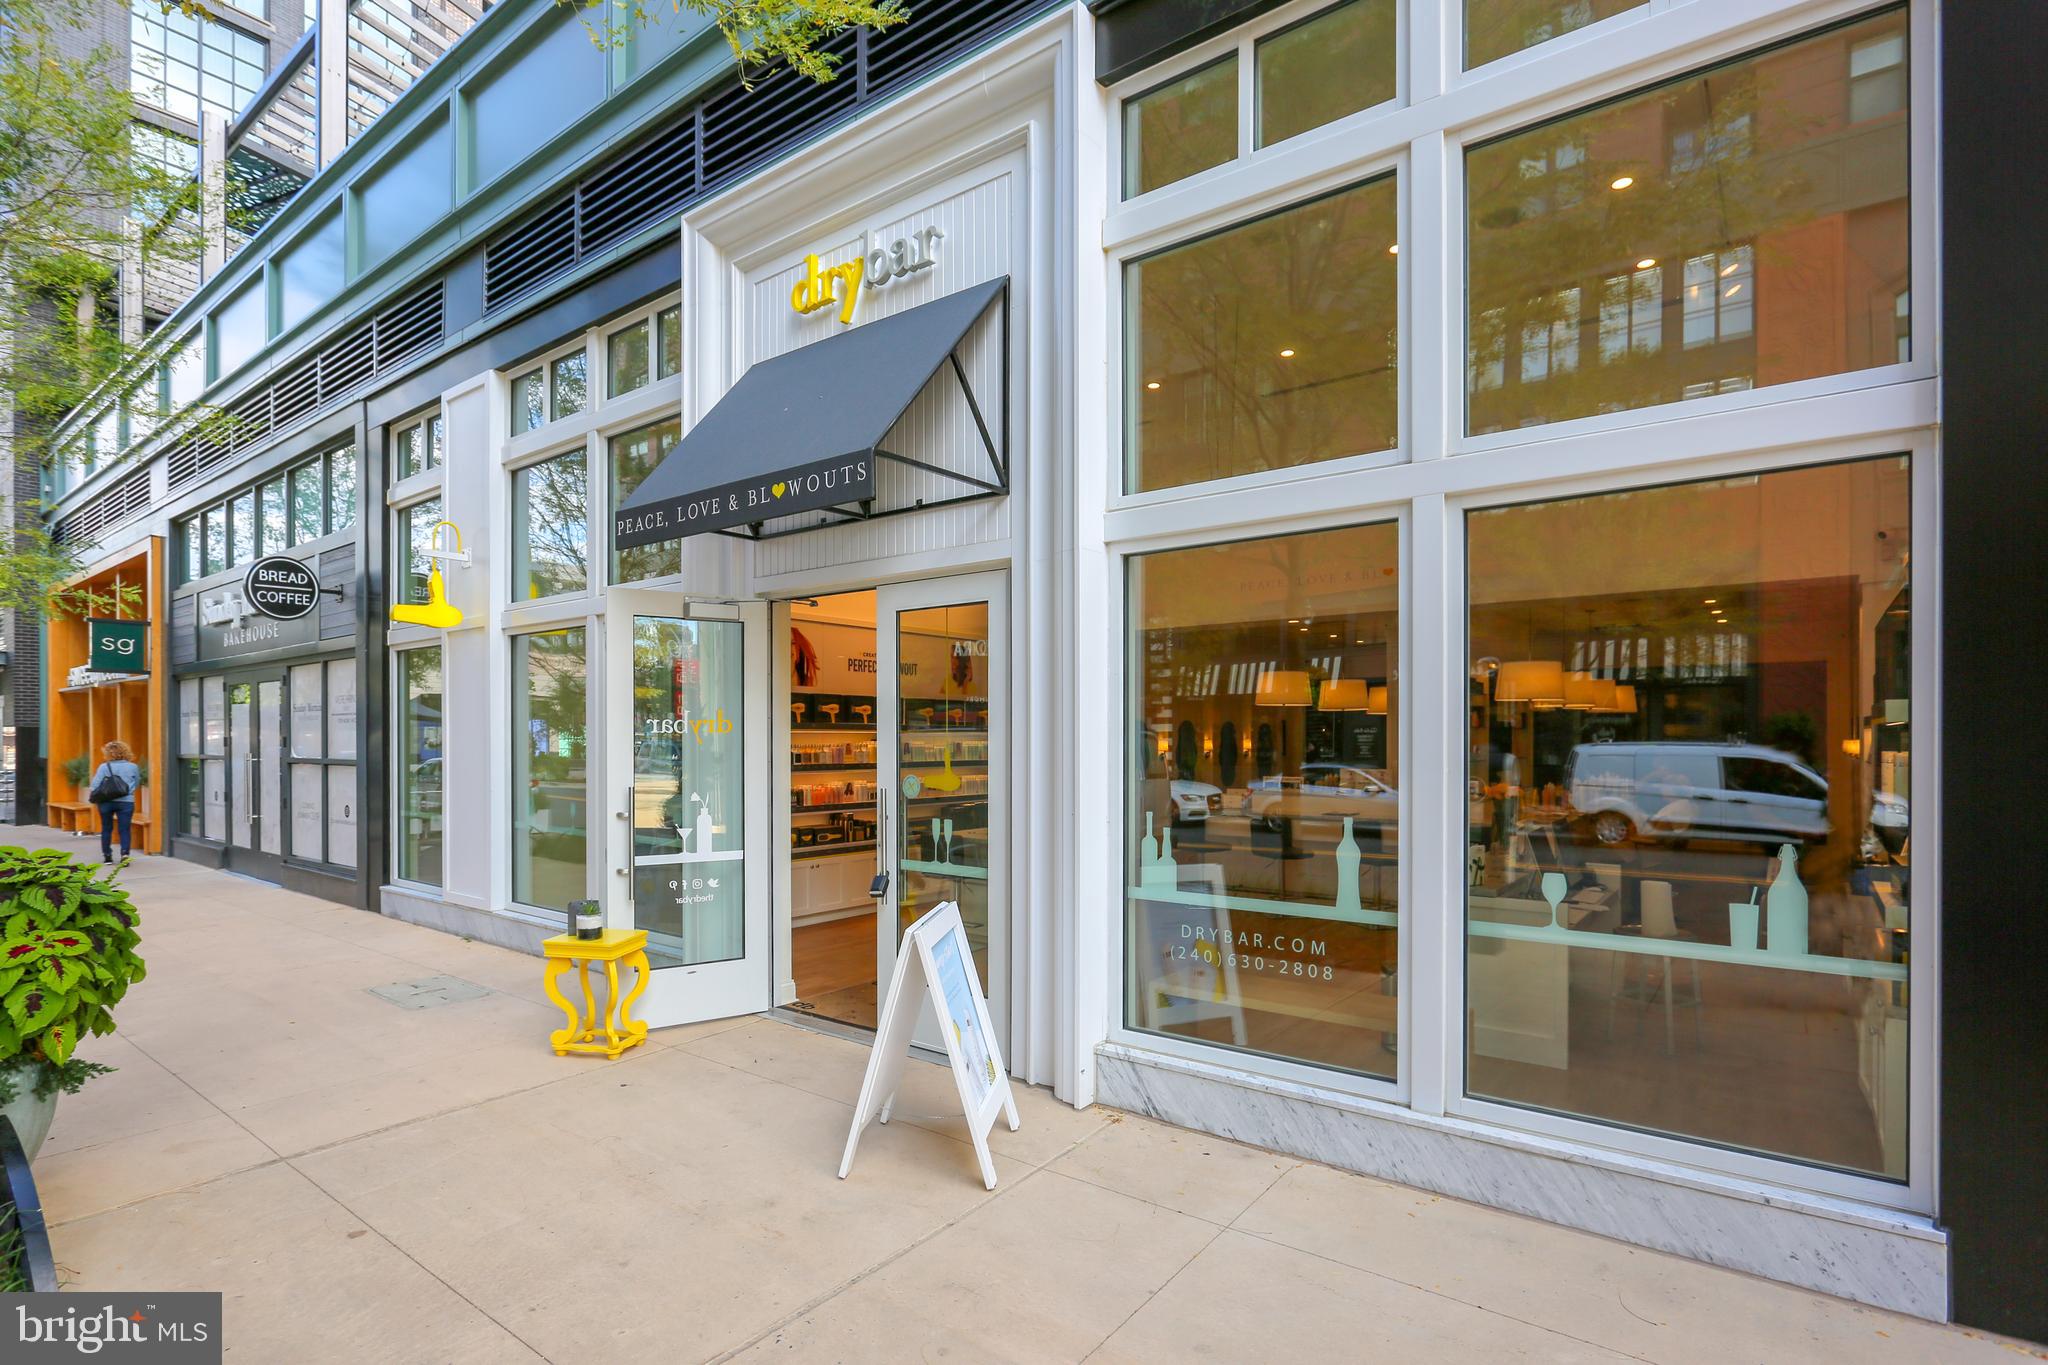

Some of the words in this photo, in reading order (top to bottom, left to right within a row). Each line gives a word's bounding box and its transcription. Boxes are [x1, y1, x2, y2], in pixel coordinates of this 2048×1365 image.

[791, 225, 944, 325] drybar
[617, 511, 669, 536] PEACE,
[677, 498, 721, 523] LOVE
[728, 494, 739, 511] &
[259, 569, 308, 585] BREAD
[257, 590, 311, 606] COFFEE
[101, 637, 136, 655] sg
[223, 621, 280, 648] BAKEHOUSE
[848, 658, 877, 673] PERFEC
[1181, 924, 1326, 956] DRYBAR.COM
[1170, 945, 1333, 981] (240)630-2808
